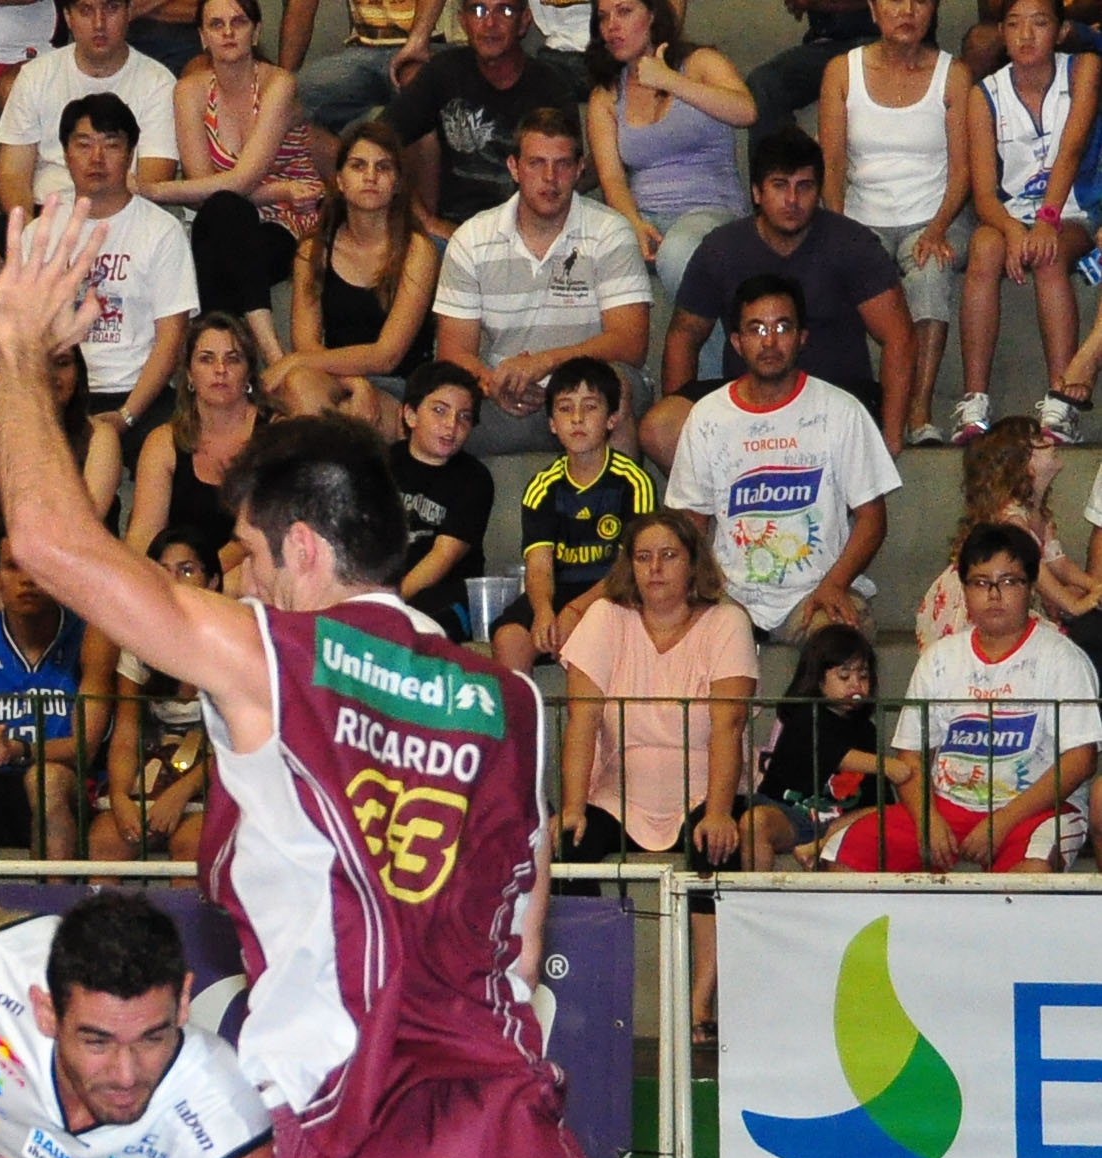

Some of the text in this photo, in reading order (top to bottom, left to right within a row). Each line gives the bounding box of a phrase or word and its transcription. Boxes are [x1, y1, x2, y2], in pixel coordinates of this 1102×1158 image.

[743, 437, 797, 452] TORCIDA
[735, 483, 811, 506] Itabom
[323, 638, 445, 707] Unimed
[334, 706, 480, 783] RICARDO
[345, 768, 469, 904] 33
